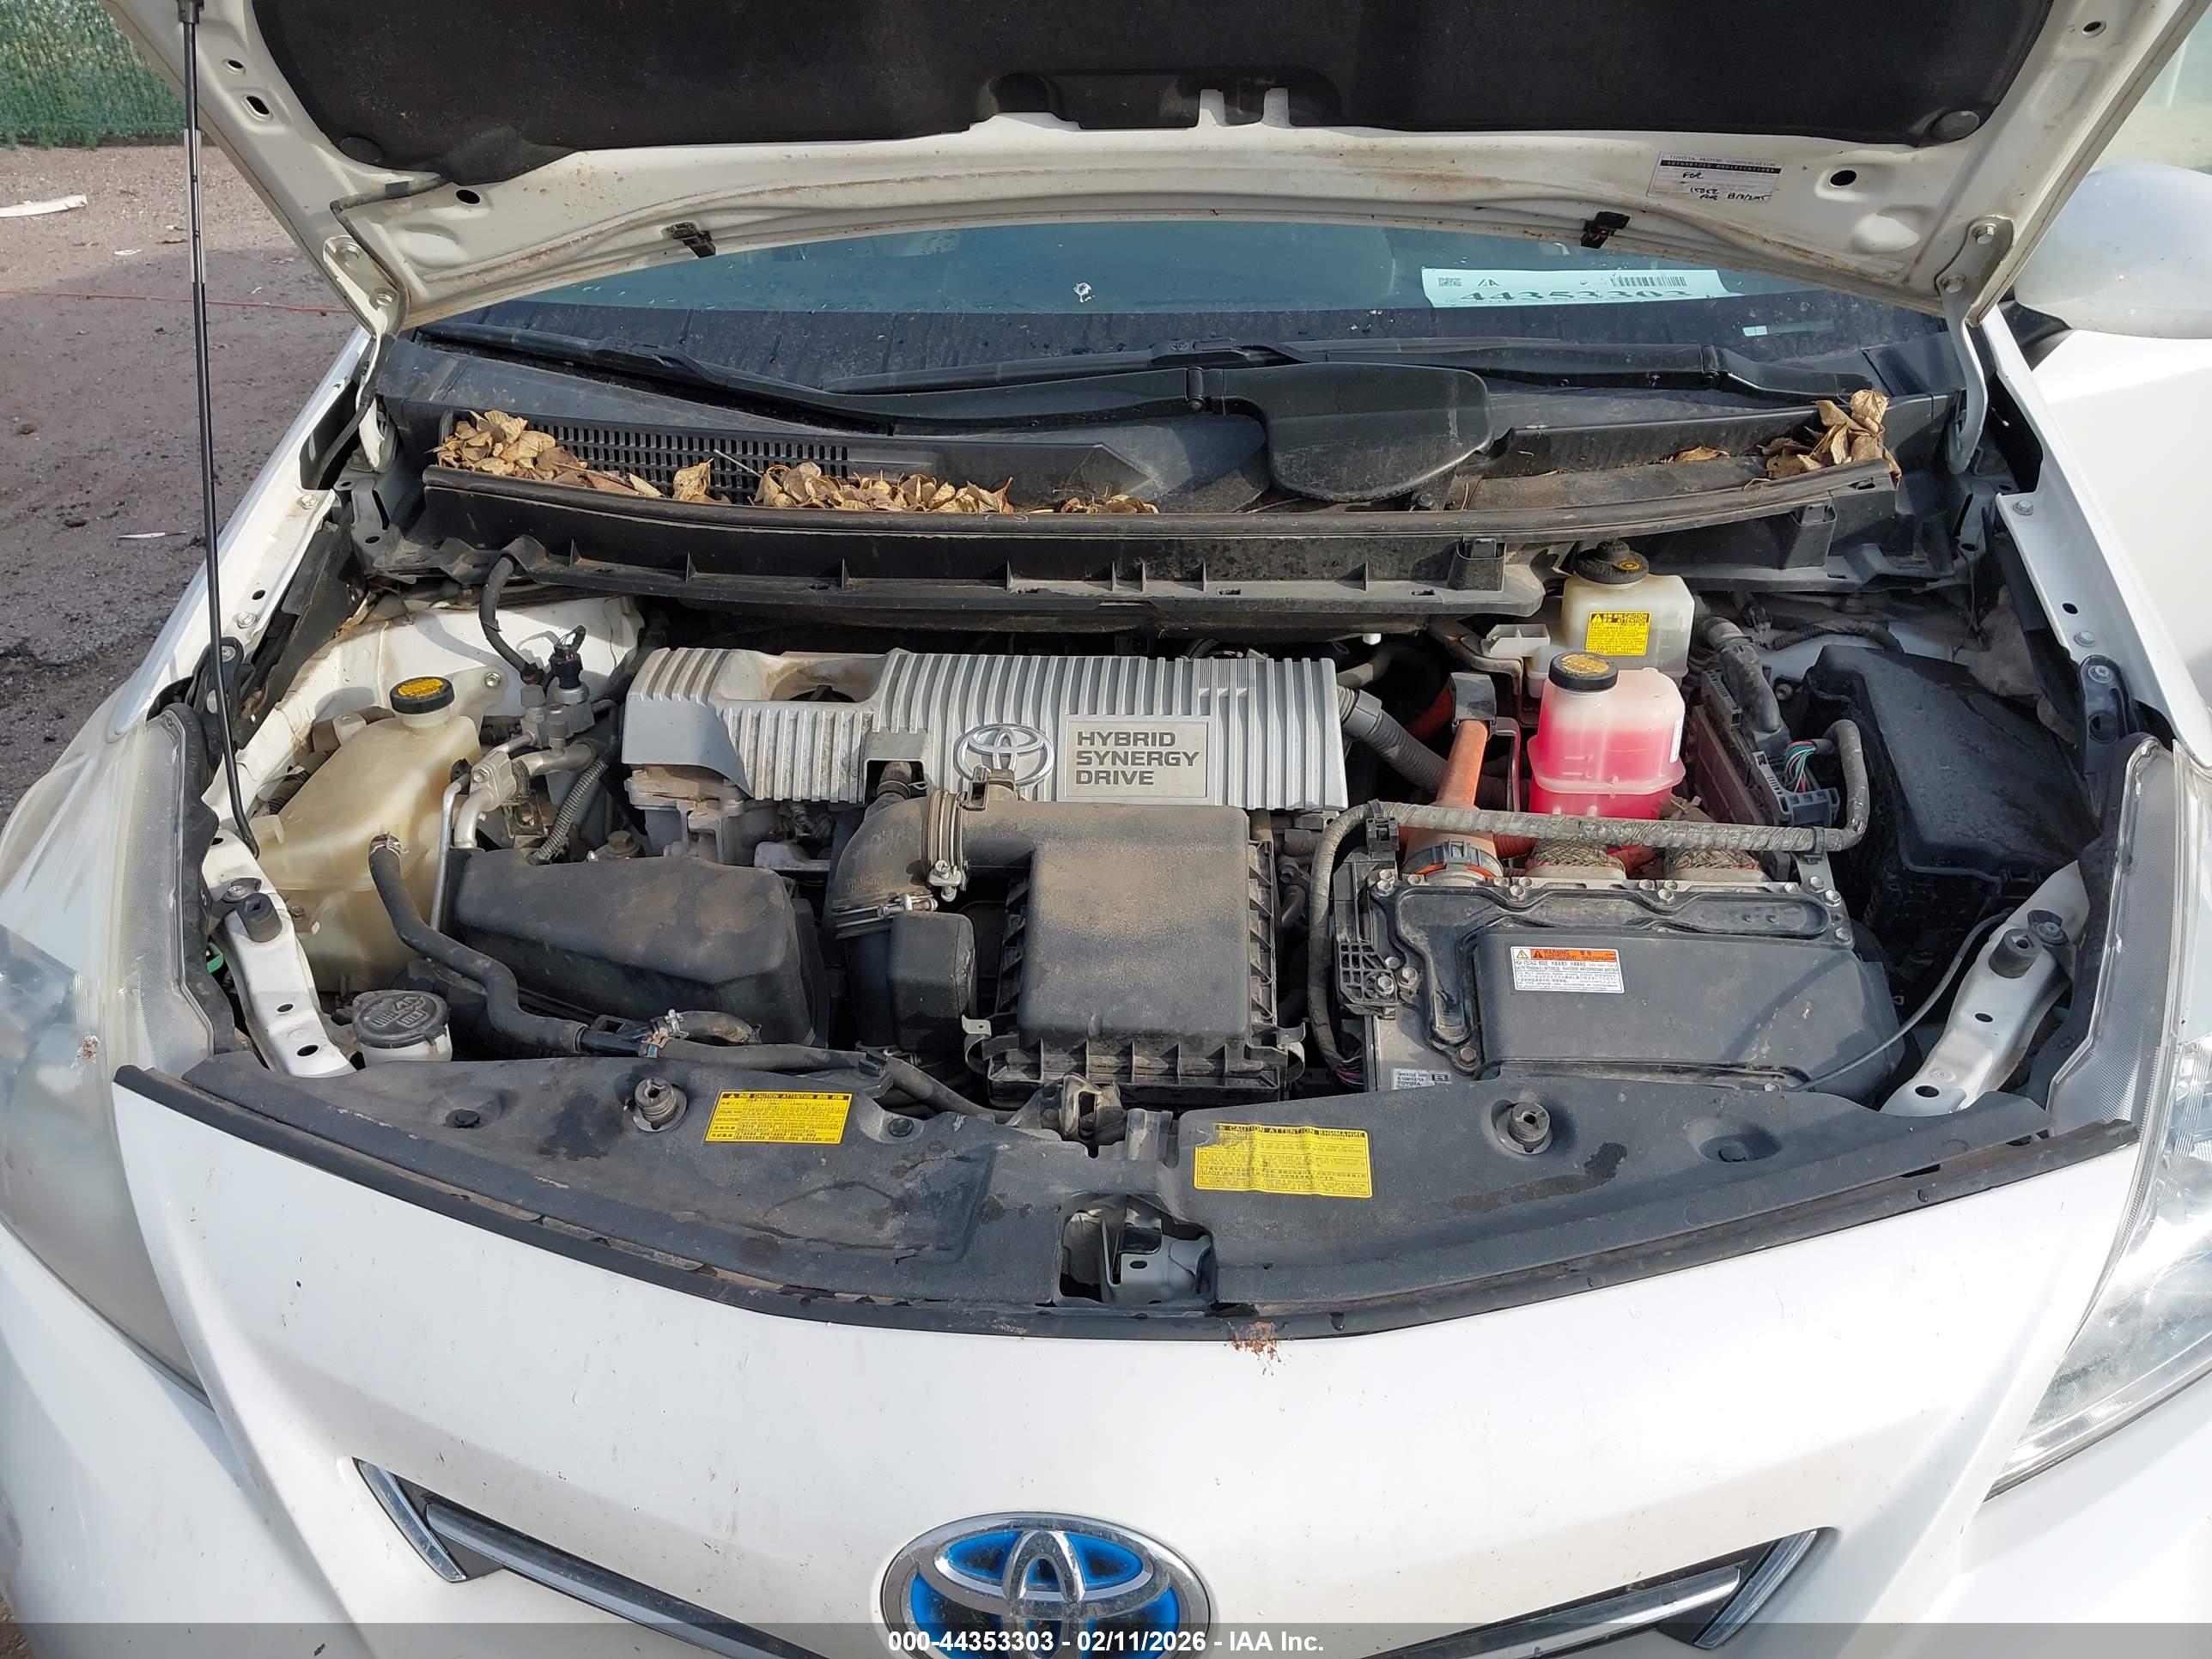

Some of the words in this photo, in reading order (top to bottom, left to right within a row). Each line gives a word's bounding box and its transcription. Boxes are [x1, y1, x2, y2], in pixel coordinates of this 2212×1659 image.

[1077, 732, 1176, 746] HYBRID
[1076, 750, 1200, 766] SYNERGY
[1076, 770, 1154, 785] DRIVE
